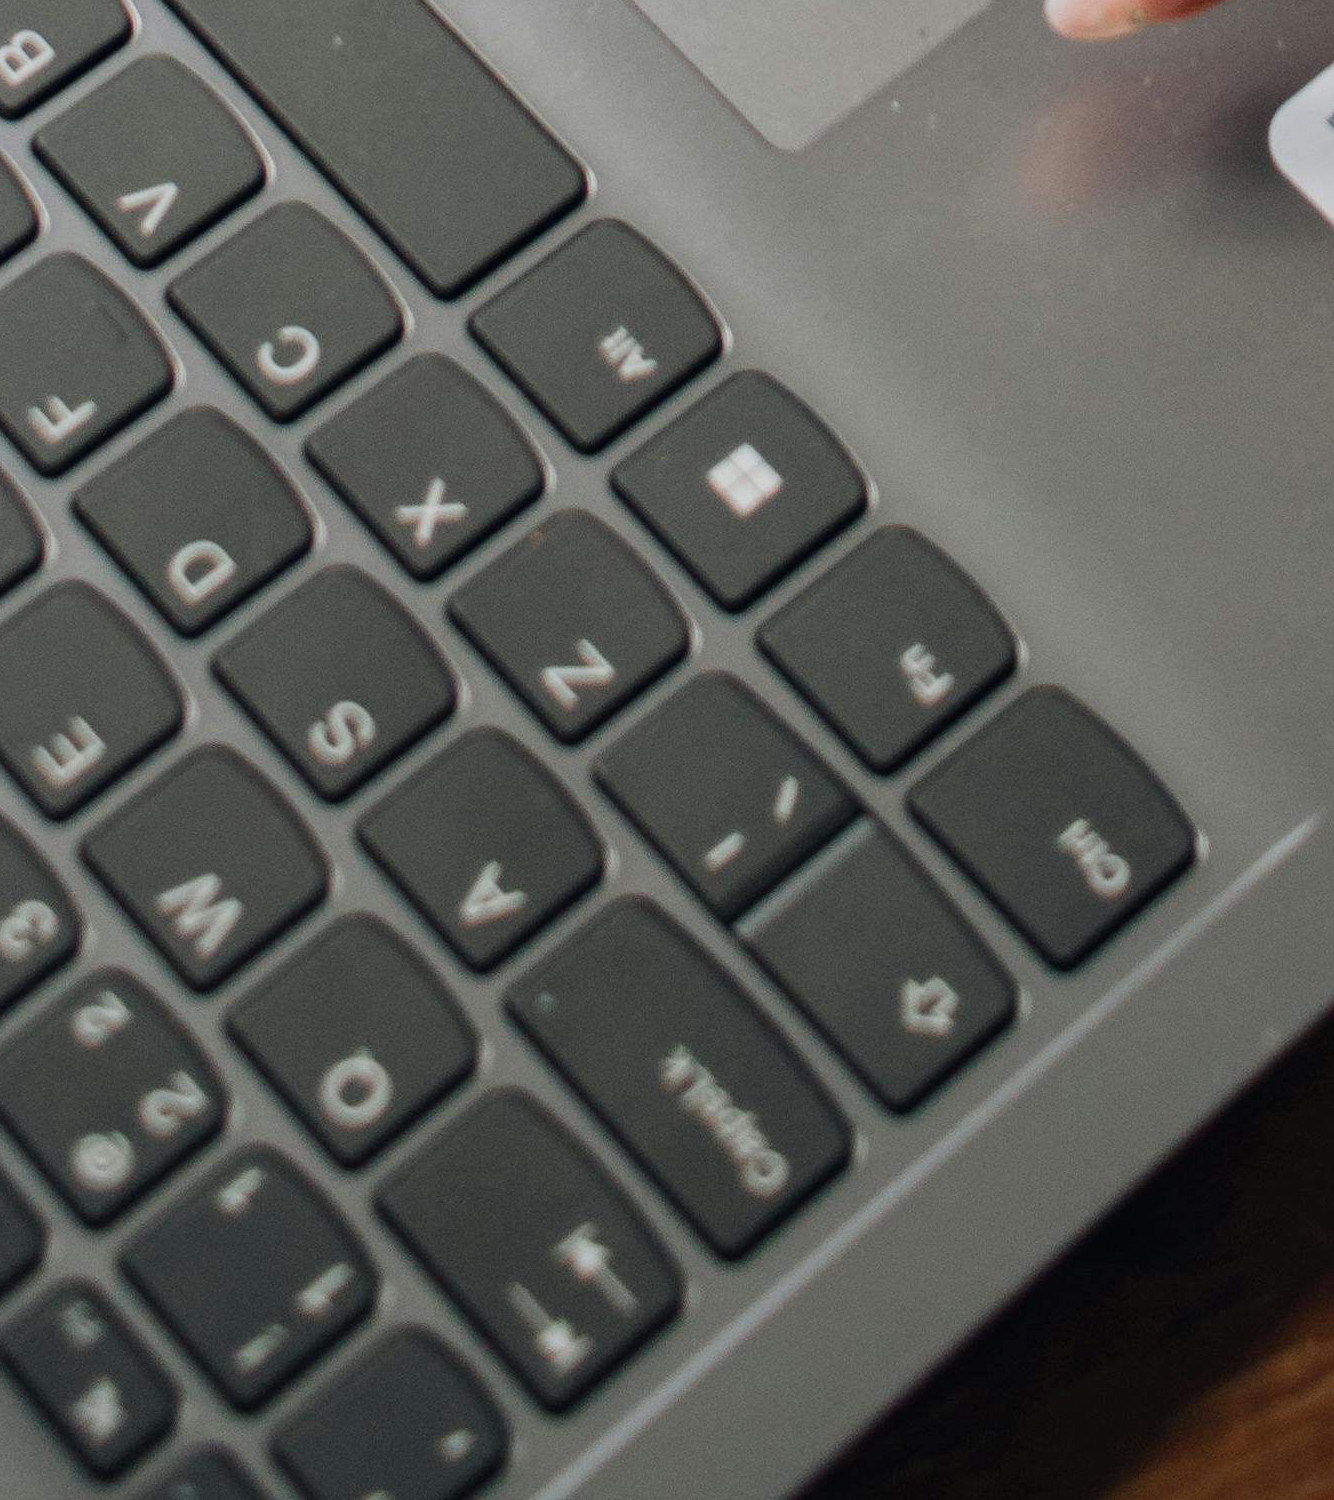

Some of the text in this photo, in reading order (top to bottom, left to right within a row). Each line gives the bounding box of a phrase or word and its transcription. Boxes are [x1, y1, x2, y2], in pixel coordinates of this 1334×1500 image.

[119, 184, 177, 234] V
[258, 327, 319, 382] C
[601, 327, 655, 379] Alt
[30, 398, 95, 442] F
[397, 479, 466, 544] X
[169, 542, 235, 603] D
[542, 641, 614, 706] Z
[901, 645, 952, 703] Fn
[35, 718, 104, 785] E
[310, 703, 374, 762] S
[1059, 820, 1129, 895] Ctrl
[158, 875, 241, 955] W
[461, 863, 524, 922] A
[141, 1073, 206, 1134] 2
[661, 1045, 787, 1198] CapsLk
